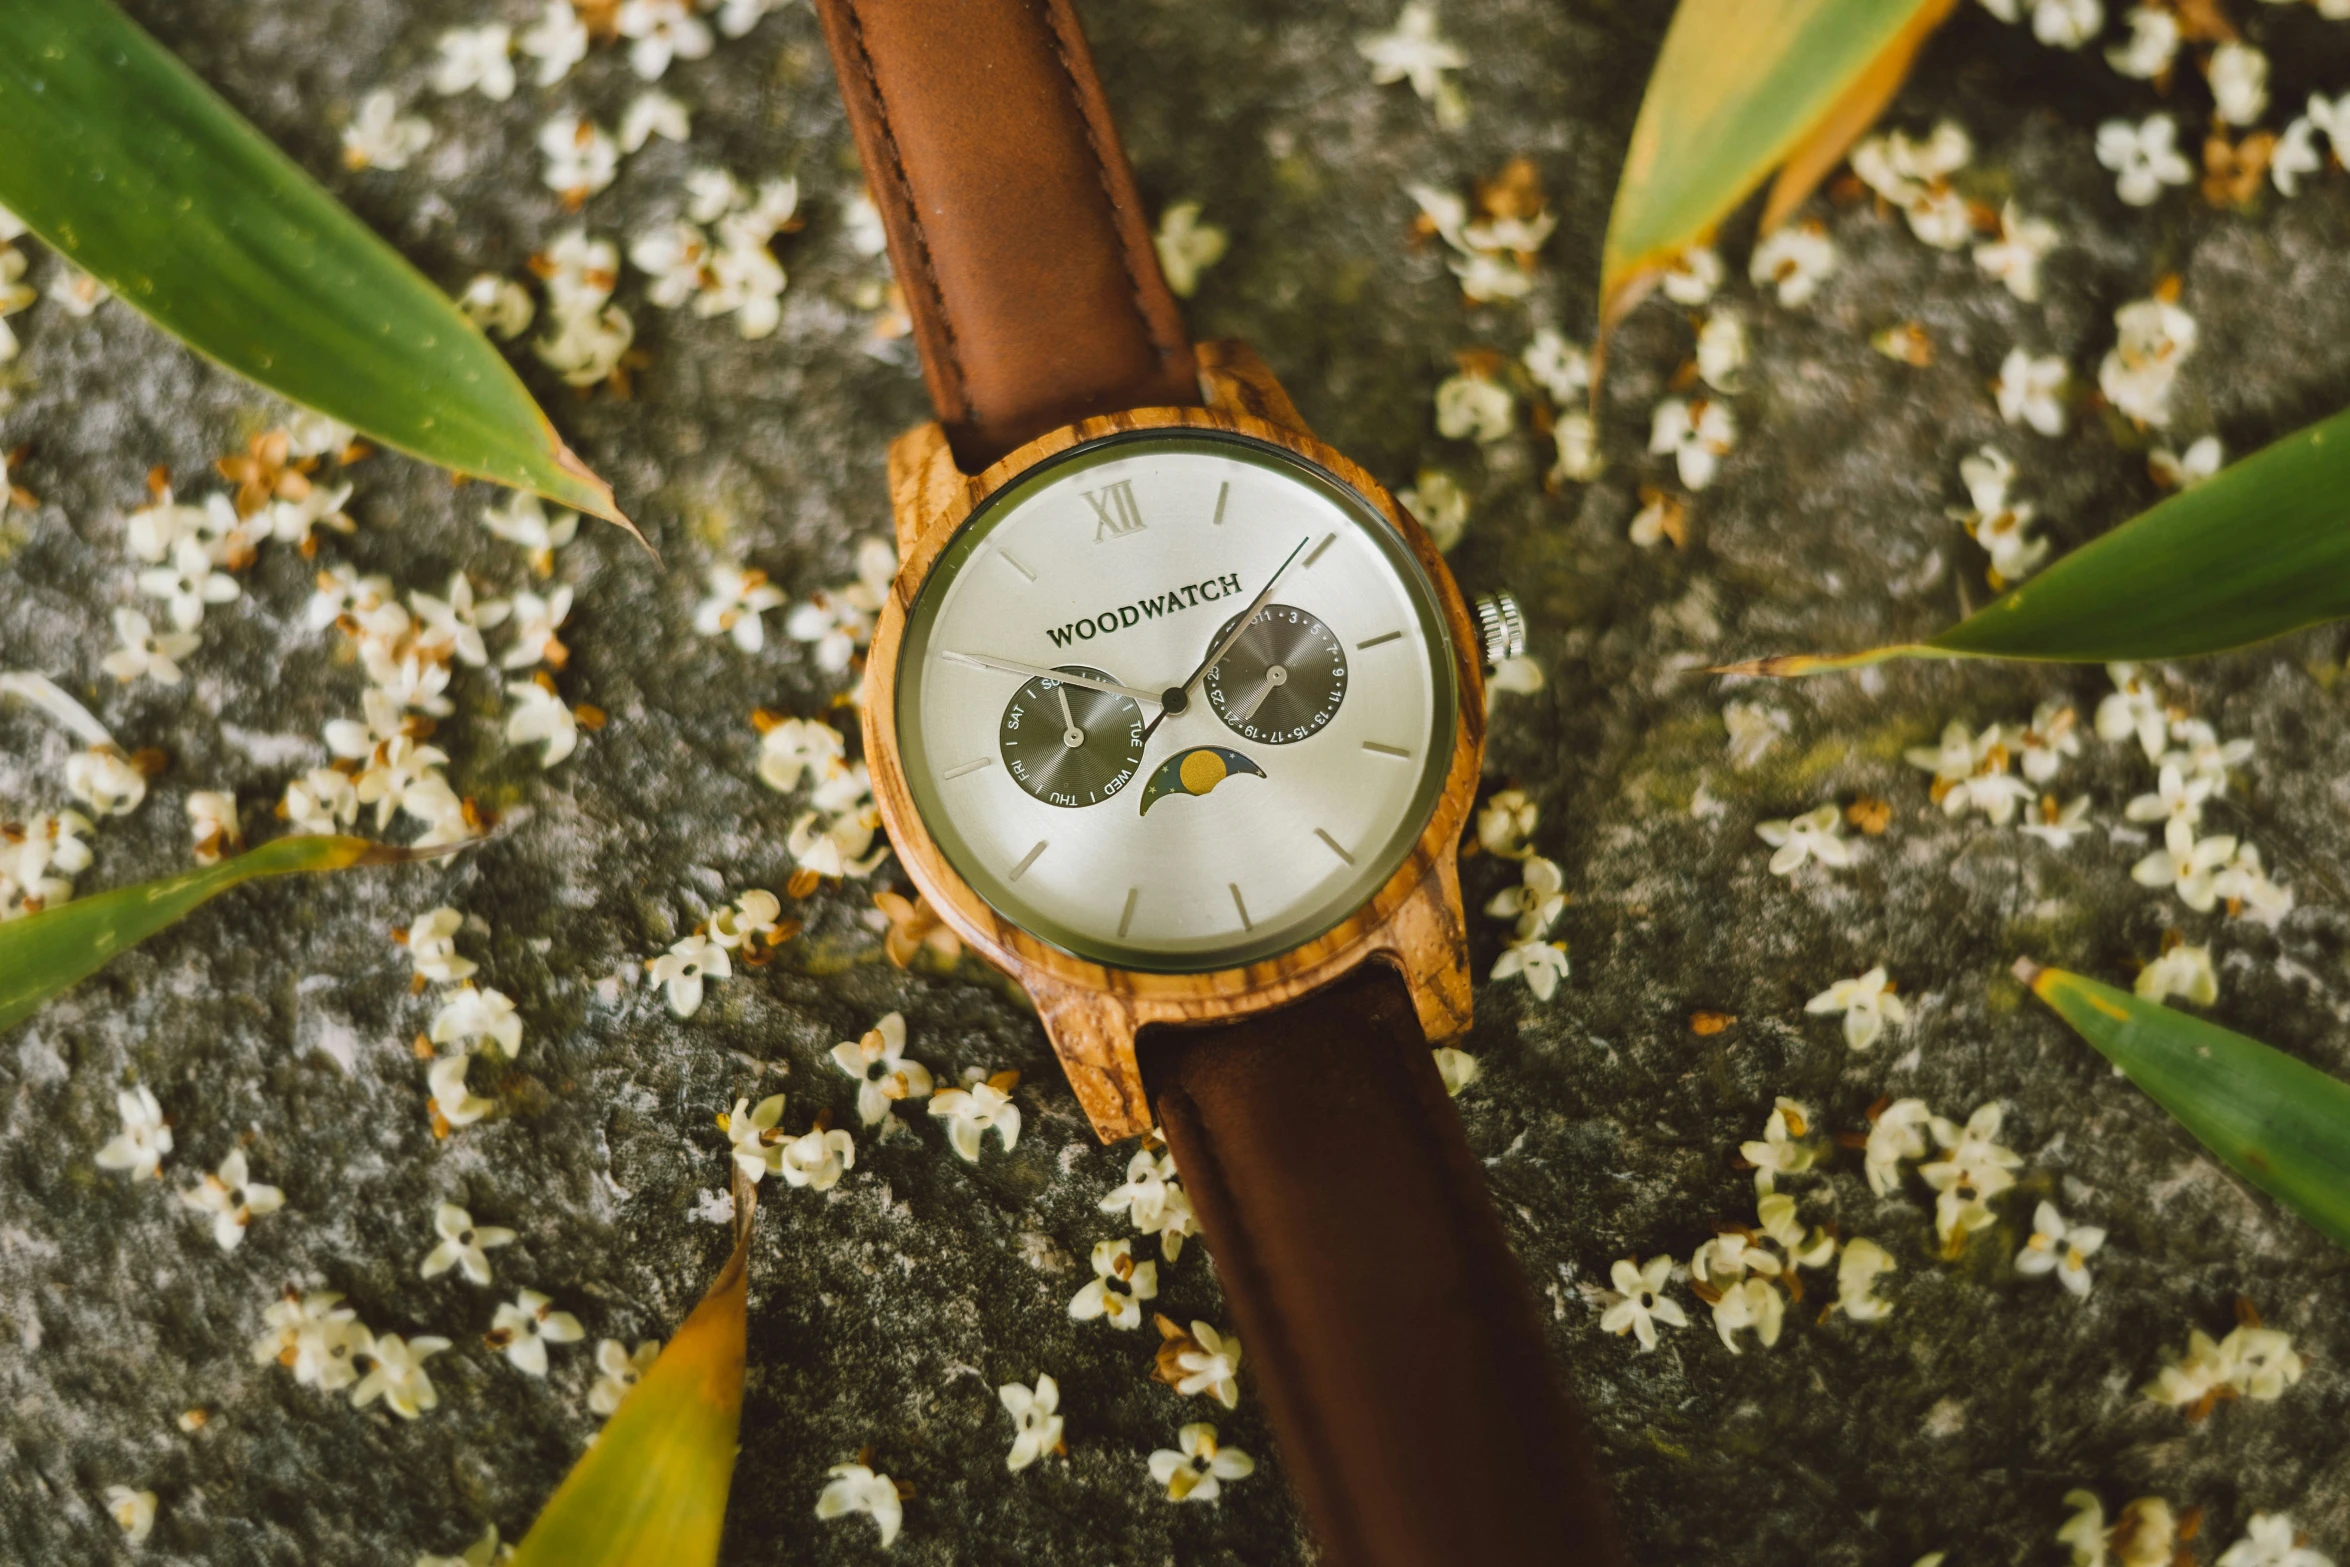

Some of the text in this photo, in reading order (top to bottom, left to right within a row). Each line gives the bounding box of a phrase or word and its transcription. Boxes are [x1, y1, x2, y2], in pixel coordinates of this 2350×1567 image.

[1080, 479, 1147, 544] XII
[1046, 573, 1243, 649] WOODWATCH
[1288, 611, 1298, 624] 3
[1310, 623, 1322, 635] 5
[1326, 643, 1339, 653] 7
[1332, 668, 1345, 677] 9
[1041, 678, 1064, 690] SU
[1210, 689, 1225, 705] 23
[1328, 690, 1342, 703] 11
[1008, 704, 1025, 730] SAT
[1223, 710, 1240, 726] 21
[1314, 711, 1329, 726] 13
[1130, 720, 1143, 748] TUE
[1244, 725, 1258, 739] 19
[1270, 732, 1284, 743] 17
[1293, 726, 1309, 740] 15
[1011, 760, 1030, 781] FRI
[1104, 769, 1132, 796] WED
[1050, 792, 1078, 806] THU
